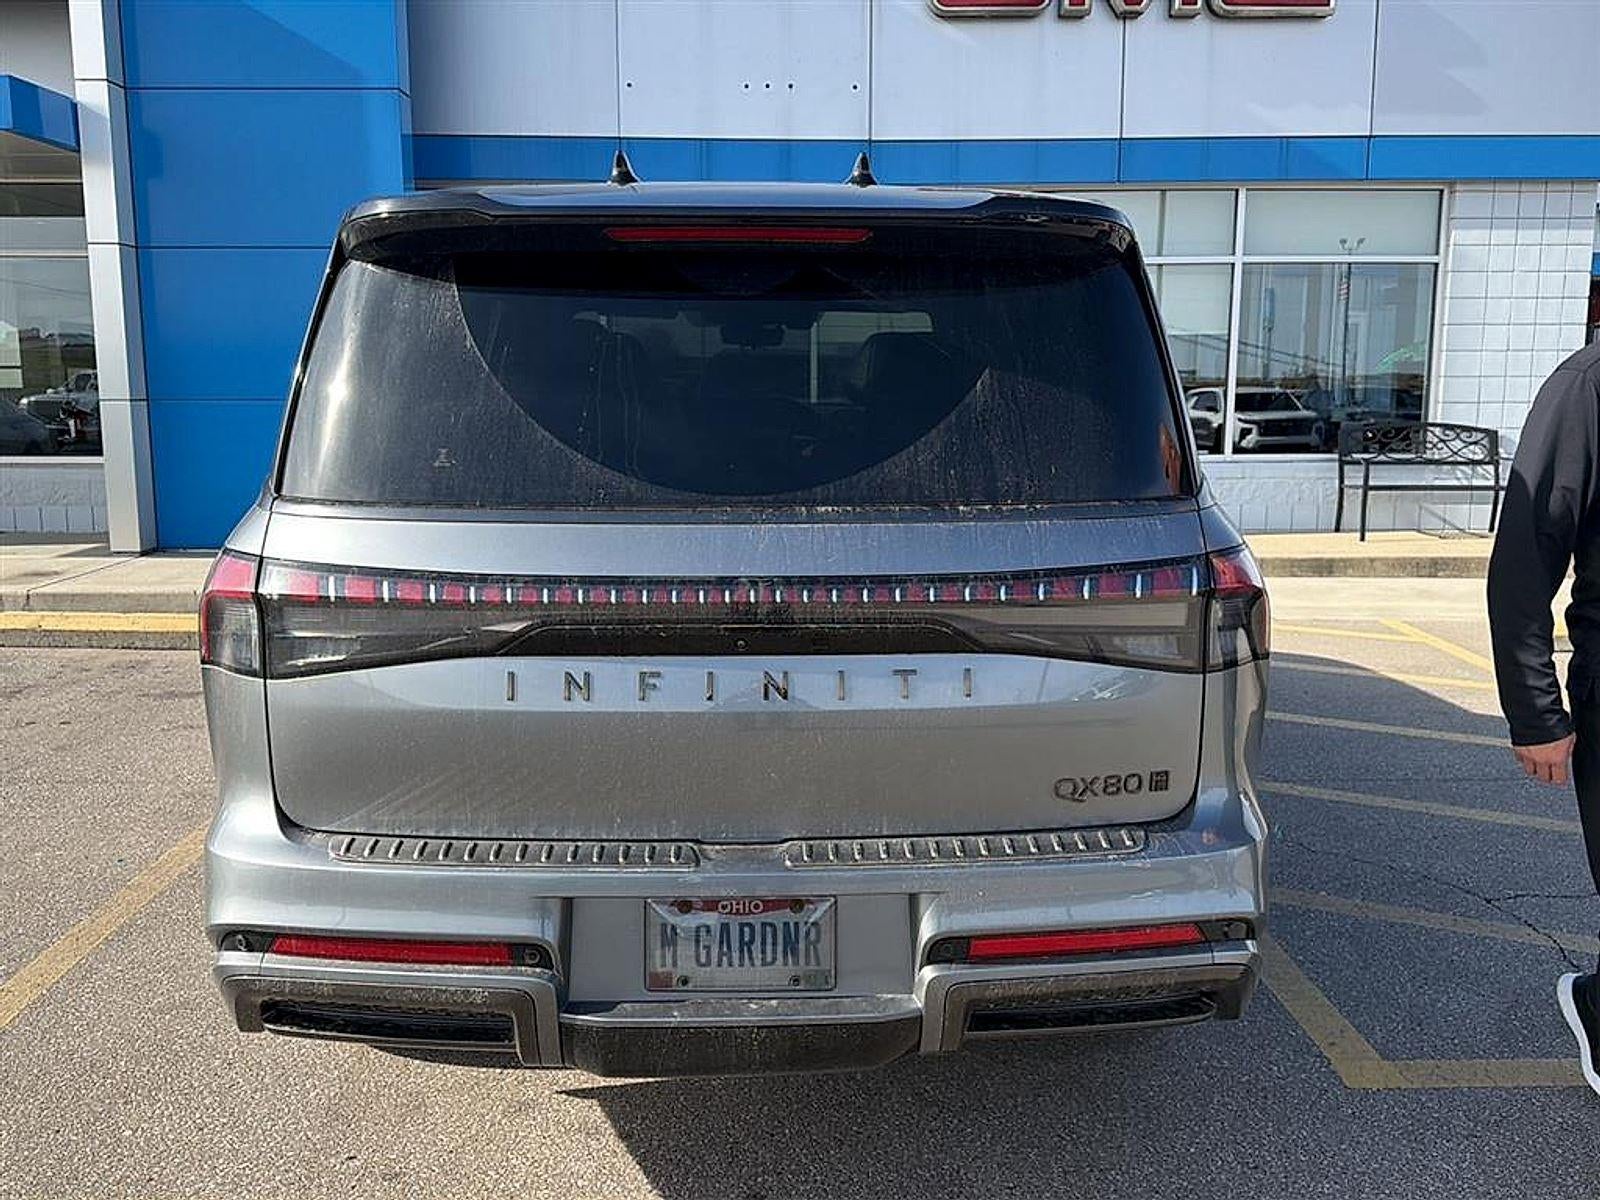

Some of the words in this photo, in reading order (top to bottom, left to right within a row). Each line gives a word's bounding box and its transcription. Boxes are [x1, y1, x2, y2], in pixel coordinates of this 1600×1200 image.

[504, 668, 973, 702] INFINITI
[1054, 773, 1143, 803] QX80
[717, 900, 764, 914] OHIO
[694, 920, 822, 968] GARDNR
